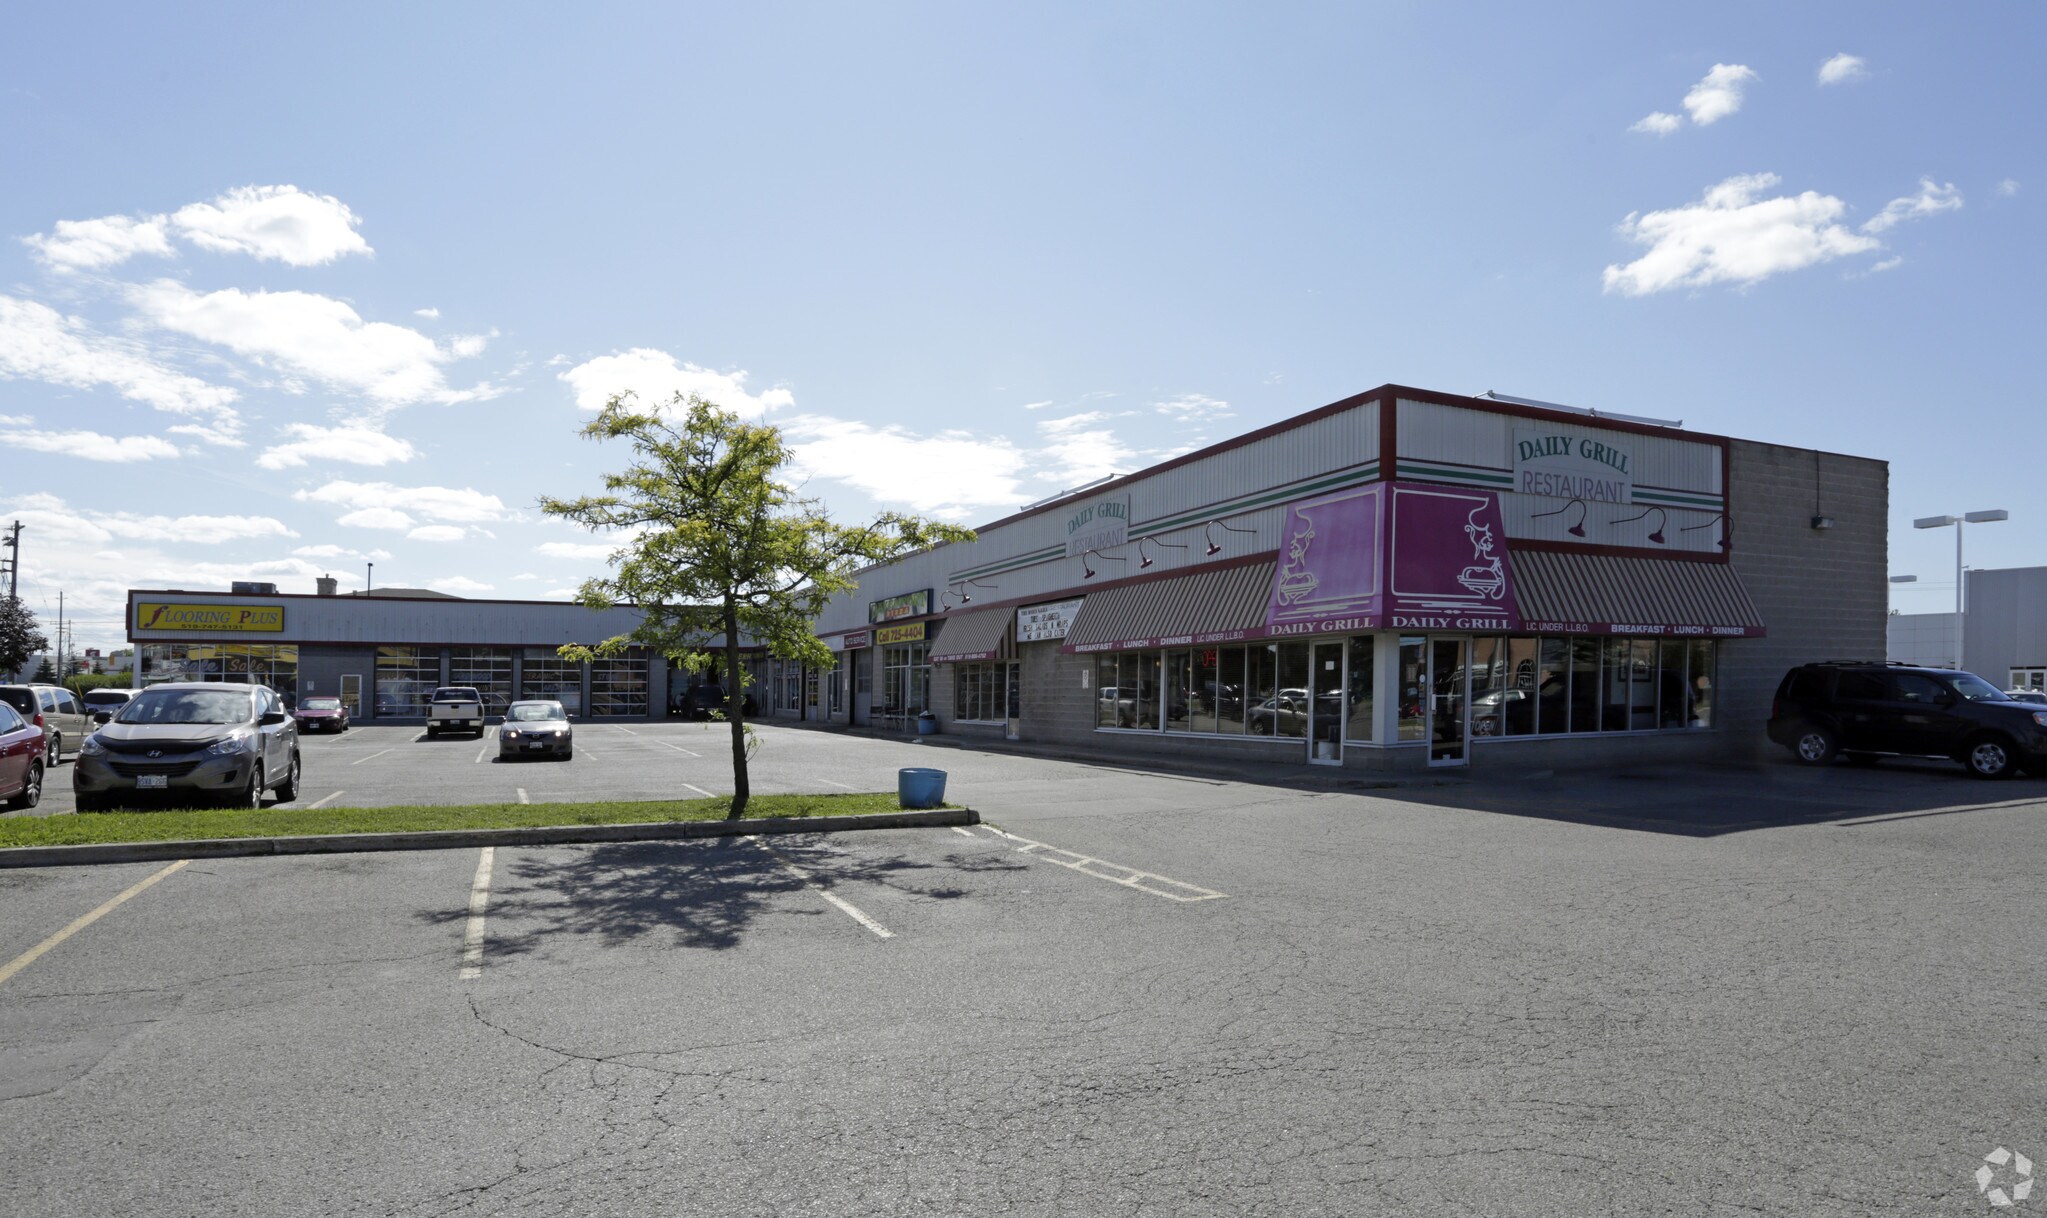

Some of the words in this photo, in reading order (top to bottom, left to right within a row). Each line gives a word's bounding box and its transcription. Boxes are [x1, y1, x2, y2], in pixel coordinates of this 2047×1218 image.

[1518, 436, 1574, 462] DAILY
[1580, 439, 1629, 475] GRILL
[1522, 470, 1625, 504] RESTAURANT
[1067, 506, 1095, 536] DAILY
[1097, 502, 1127, 520] GRILL
[1069, 527, 1125, 558] RESTAURANT
[238, 610, 278, 625] PLUS
[1270, 622, 1317, 636] DAILY
[1320, 617, 1374, 631] GRILL
[1392, 616, 1451, 629] DAILY
[1456, 618, 1512, 630] GRILL
[879, 631, 889, 643] Call
[891, 625, 923, 642] 725-4404
[1539, 623, 1564, 632] UNDER
[1611, 624, 1665, 634] BREAKFAST
[1673, 626, 1704, 635] LUNCH
[1712, 627, 1745, 635] DINNER
[1075, 642, 1114, 652] BREAKFAST
[1123, 639, 1149, 649] LUNCH
[1160, 636, 1192, 646] DINNER
[1205, 633, 1224, 642] UNDER
[179, 658, 219, 672] Sale
[229, 659, 265, 672] Sale
[1475, 720, 1495, 732] OPEN
